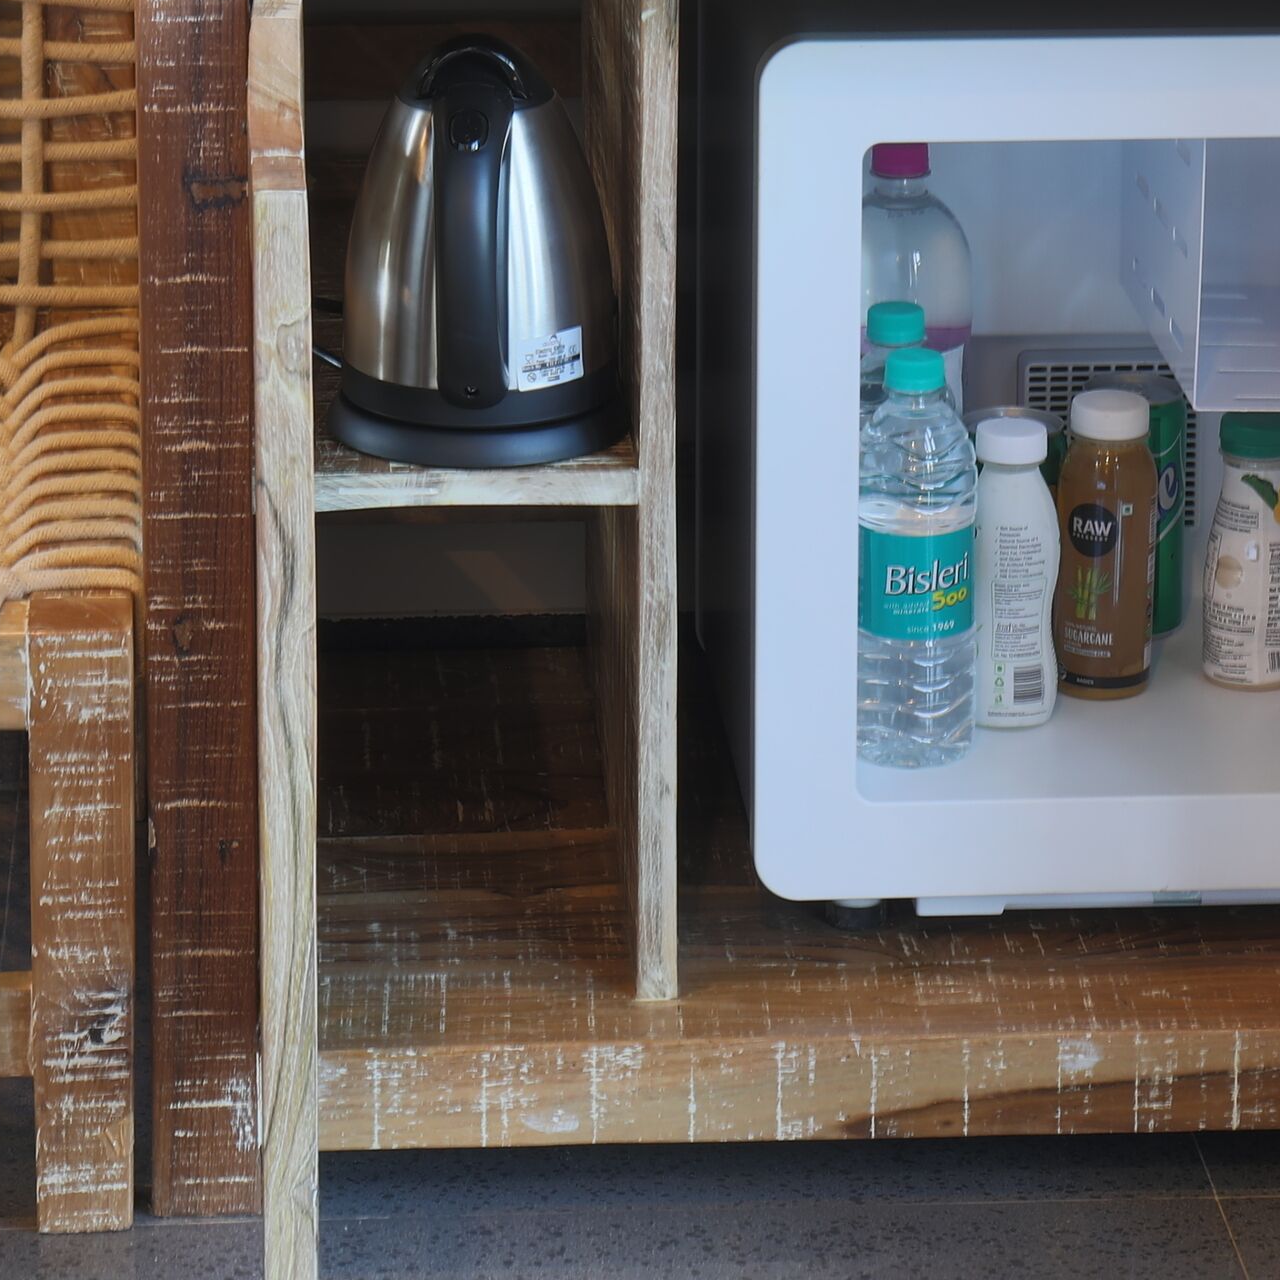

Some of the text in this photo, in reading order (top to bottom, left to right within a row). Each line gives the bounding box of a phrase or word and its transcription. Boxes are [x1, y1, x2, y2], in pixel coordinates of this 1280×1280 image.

[1072, 516, 1113, 536] RAW
[885, 552, 968, 595] Bisleri
[931, 587, 968, 612] 500
[907, 619, 955, 634] since 1969
[1064, 626, 1114, 647] SUGARCANE
